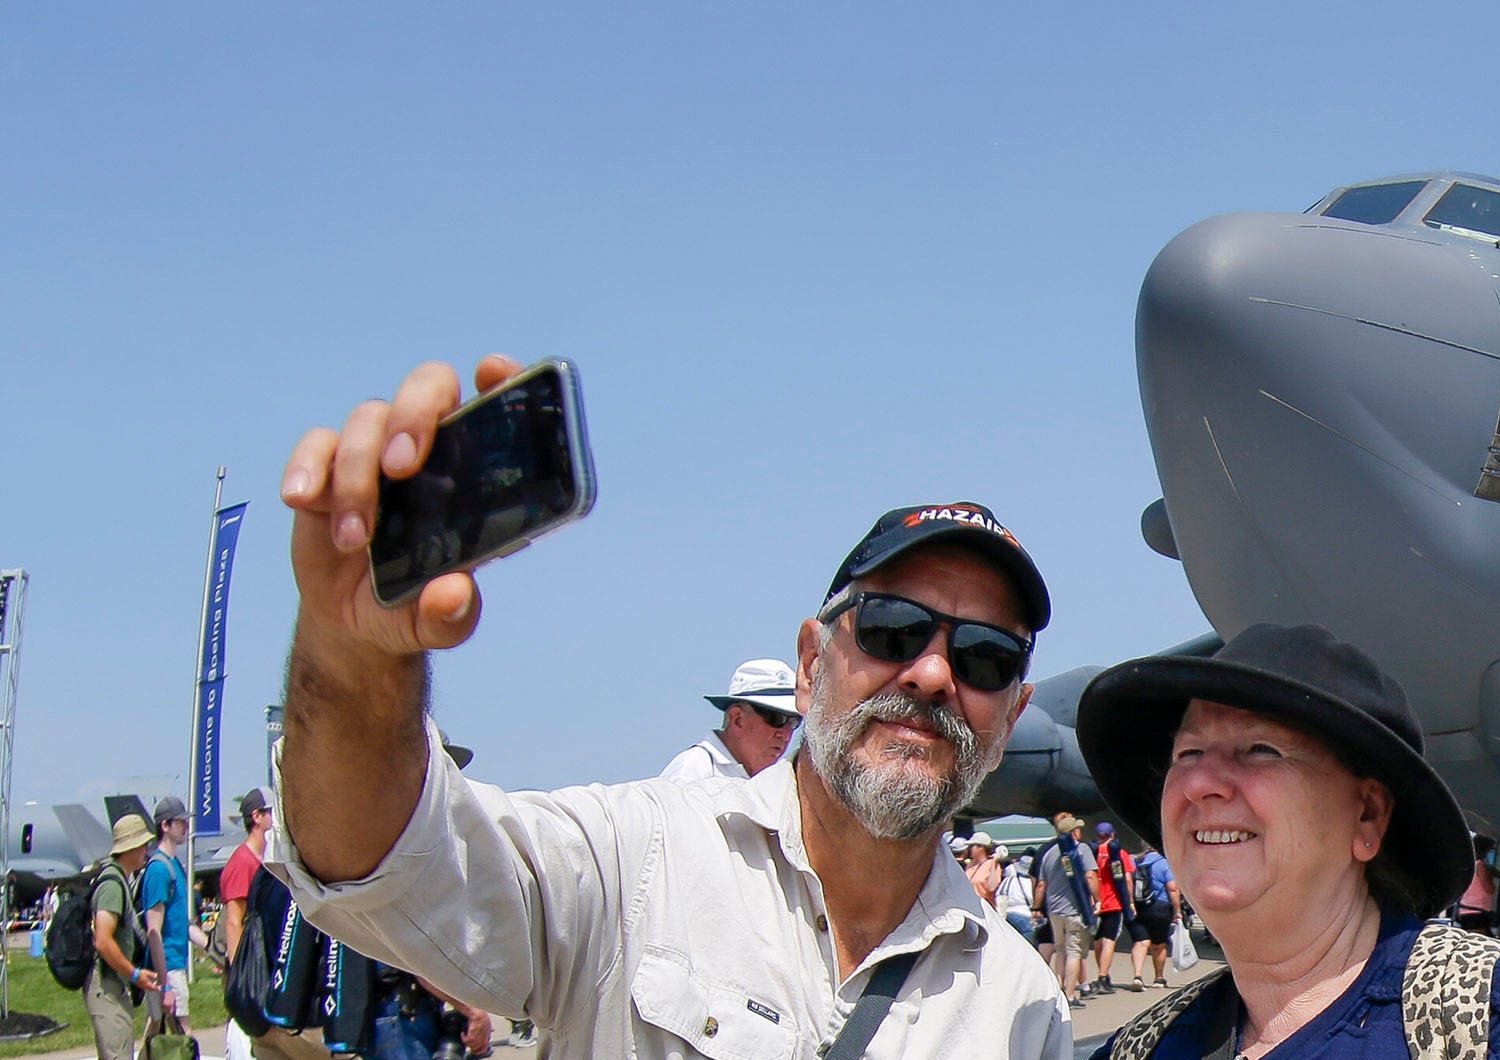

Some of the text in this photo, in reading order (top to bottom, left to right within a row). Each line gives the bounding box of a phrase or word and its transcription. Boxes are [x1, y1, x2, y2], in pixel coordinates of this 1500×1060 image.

[203, 547, 229, 816] Welcome to Boeing Plaza
